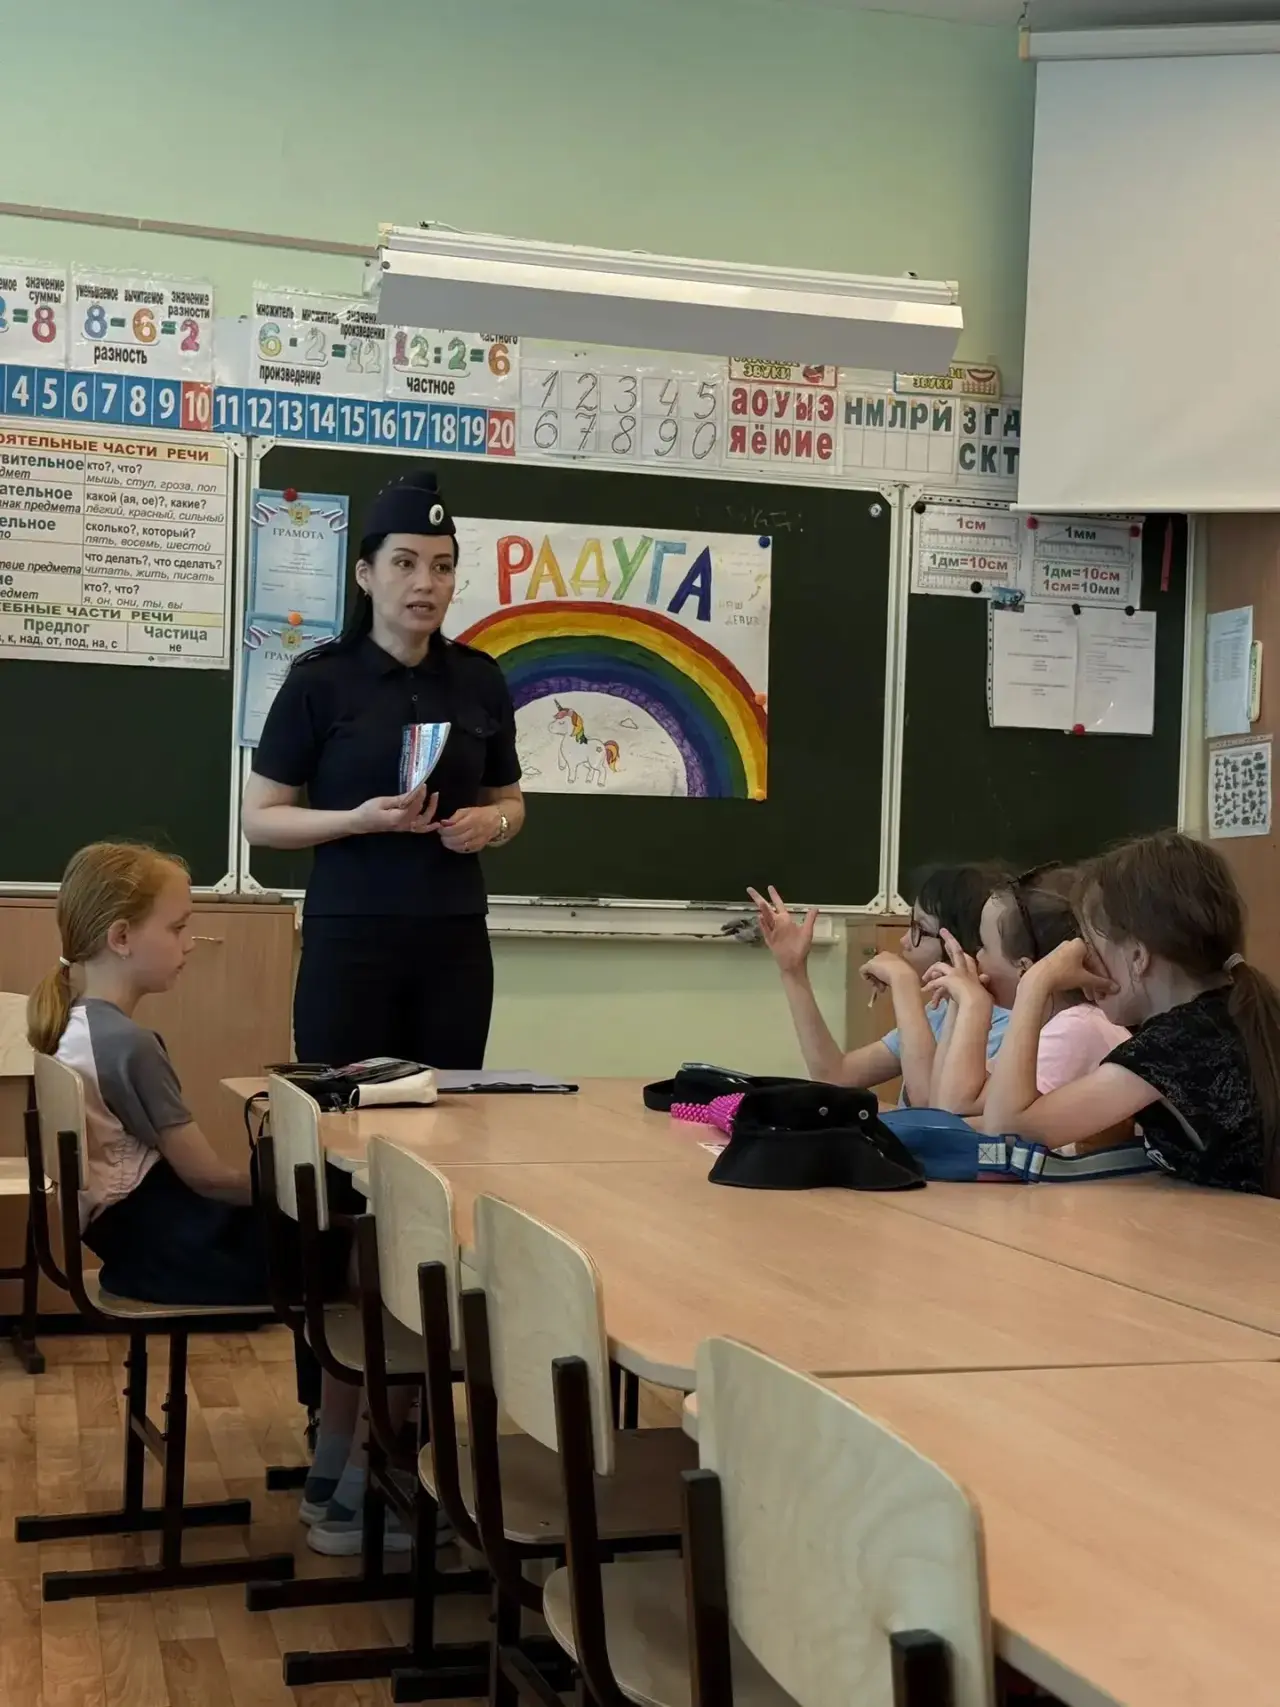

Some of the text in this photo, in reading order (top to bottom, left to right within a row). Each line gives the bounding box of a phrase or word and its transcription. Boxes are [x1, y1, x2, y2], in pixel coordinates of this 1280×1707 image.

[25, 276, 65, 292] значение
[28, 291, 61, 305] суммы
[124, 289, 164, 305] вычитаемое
[171, 291, 209, 306] значение
[168, 305, 210, 319] разности
[256, 303, 294, 319] множитель
[94, 345, 148, 364] разность
[260, 365, 321, 386] произведение
[743, 364, 791, 381] ЗВУКИ
[406, 377, 455, 396] частное
[913, 377, 953, 390] ЗВУКИ
[12, 375, 514, 449] 4 5 6 7 8 9 10 11 12 13 14 15 16 17 18 19 20
[103, 442, 157, 457] ЧАСТИ
[167, 448, 209, 462] РЕЧИ
[0, 453, 85, 471] вительное
[87, 461, 142, 474] кто?, что?
[24, 500, 81, 514] предмета
[86, 491, 117, 502] какой
[171, 499, 207, 509] какие?
[179, 511, 224, 523] сильный
[956, 517, 986, 531] 1см
[86, 522, 196, 539] сколько?, который?
[272, 527, 325, 540] ГРАМОТА
[1065, 526, 1096, 541] 1мм
[166, 541, 211, 552] шестой
[27, 561, 82, 575] предмета
[85, 553, 222, 570] что делать?, что сделать?
[930, 553, 1008, 571] 1дм=10см
[173, 572, 215, 582] писать
[497, 534, 713, 622] РАДУГА
[1042, 564, 1120, 582] 1дм=10см
[84, 582, 140, 595] кто?, что?
[1042, 579, 1120, 596] 1см=10мм
[0, 602, 174, 622] ЕБНЫЕ ЧАСТИ РЕЧИ
[167, 602, 183, 610] вы
[24, 618, 90, 635] Предлог
[144, 626, 208, 642] Частица
[20, 635, 43, 645] над,
[46, 636, 62, 646] от,
[65, 637, 89, 648] под,
[92, 640, 108, 649] на,
[111, 641, 118, 649] с
[169, 644, 182, 652] не
